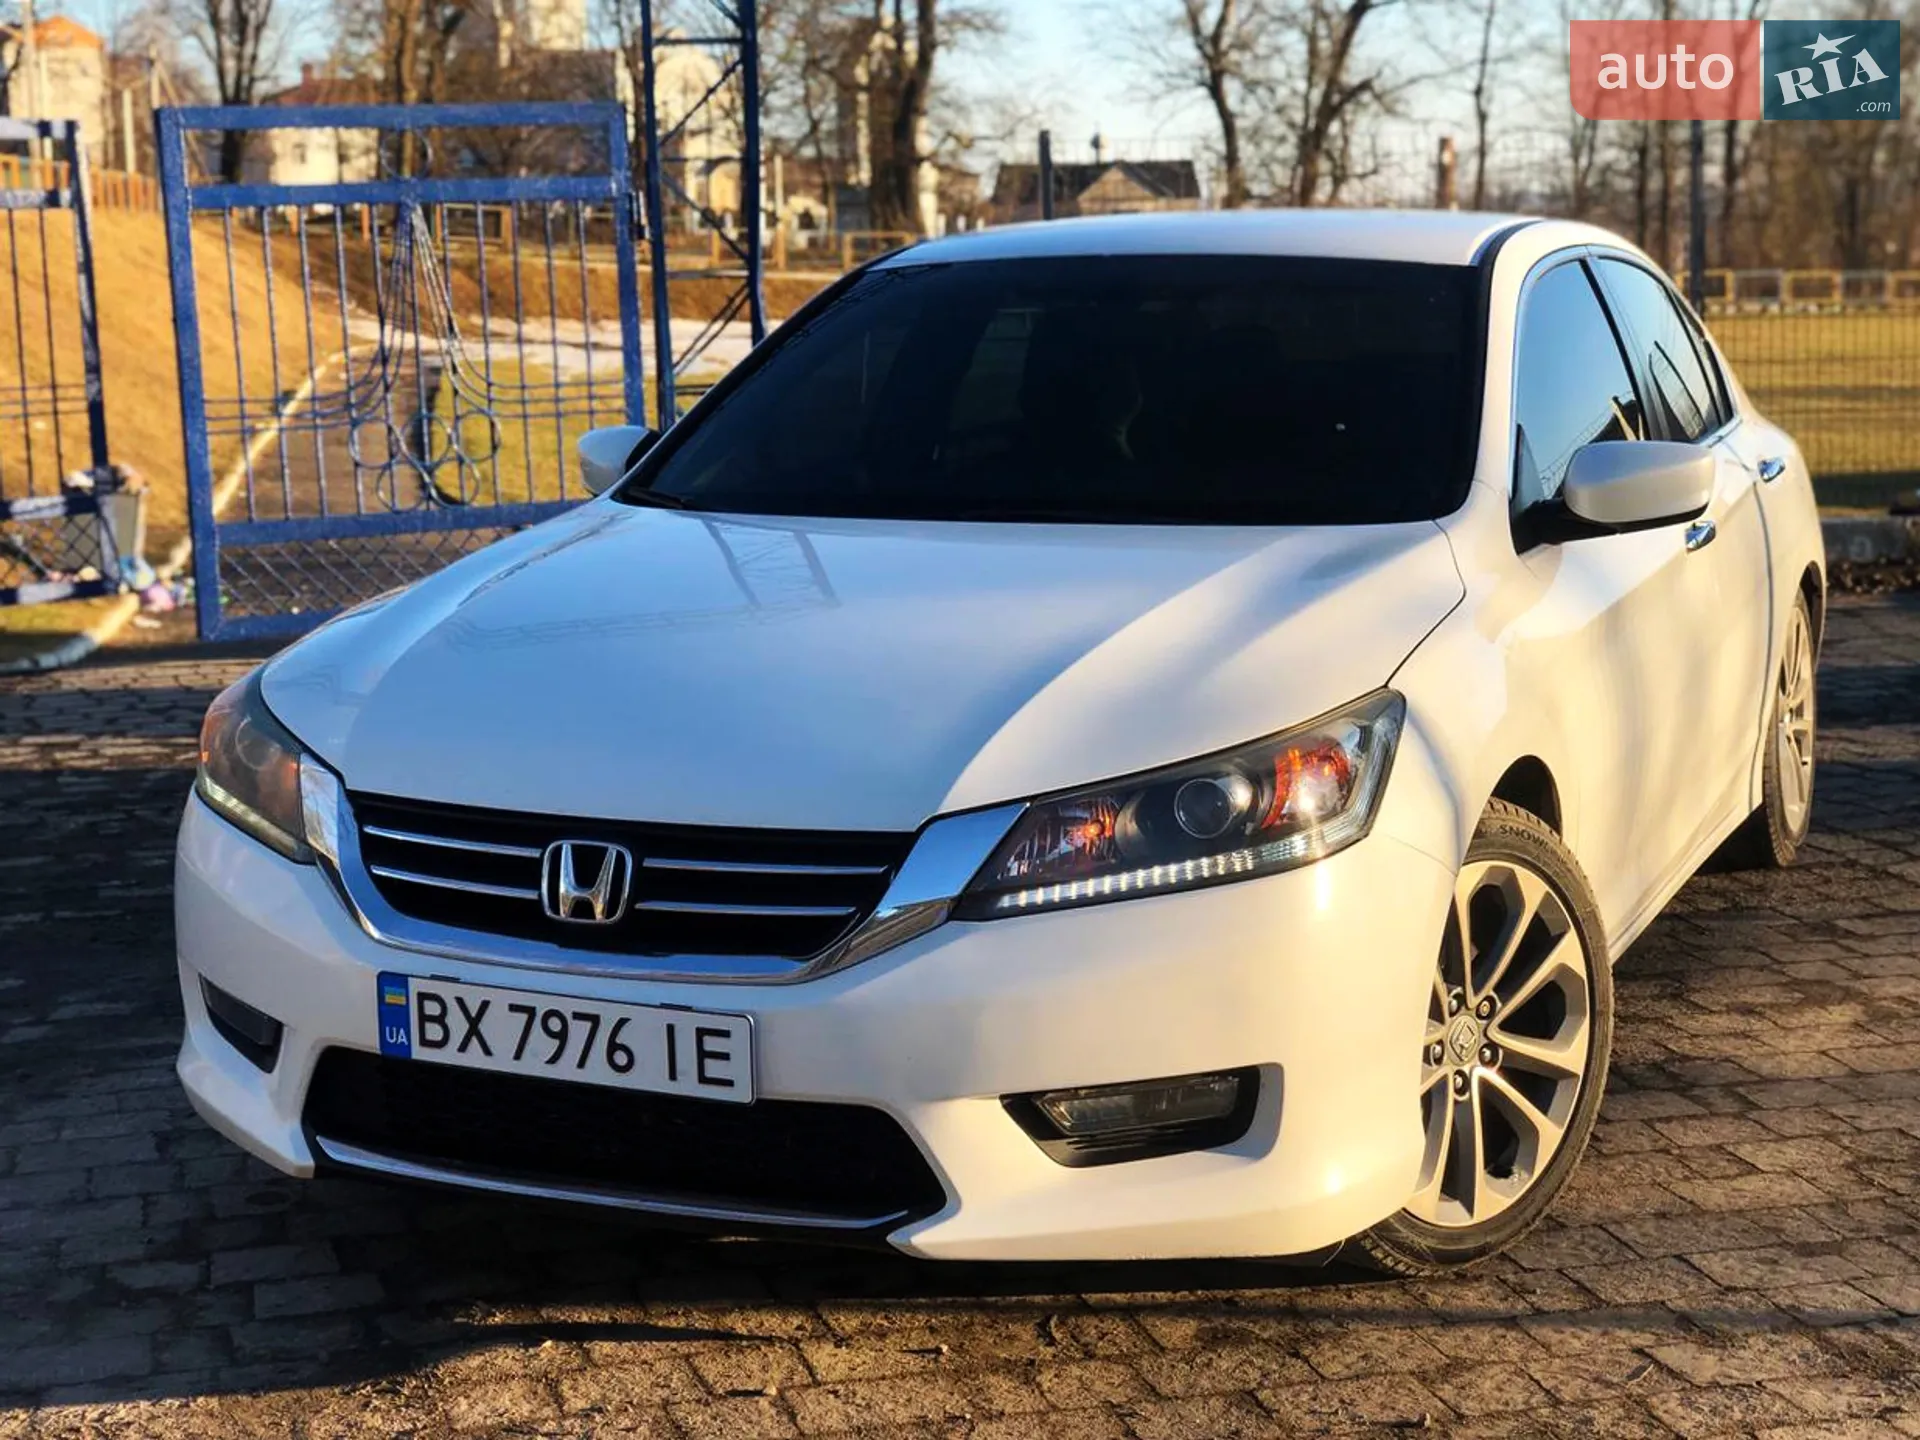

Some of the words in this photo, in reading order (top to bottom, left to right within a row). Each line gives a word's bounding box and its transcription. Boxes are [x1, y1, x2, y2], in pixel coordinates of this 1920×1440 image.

[385, 1026, 408, 1046] UA
[416, 991, 493, 1057] BX
[508, 1003, 635, 1074] 7976
[666, 1023, 734, 1087] IE
